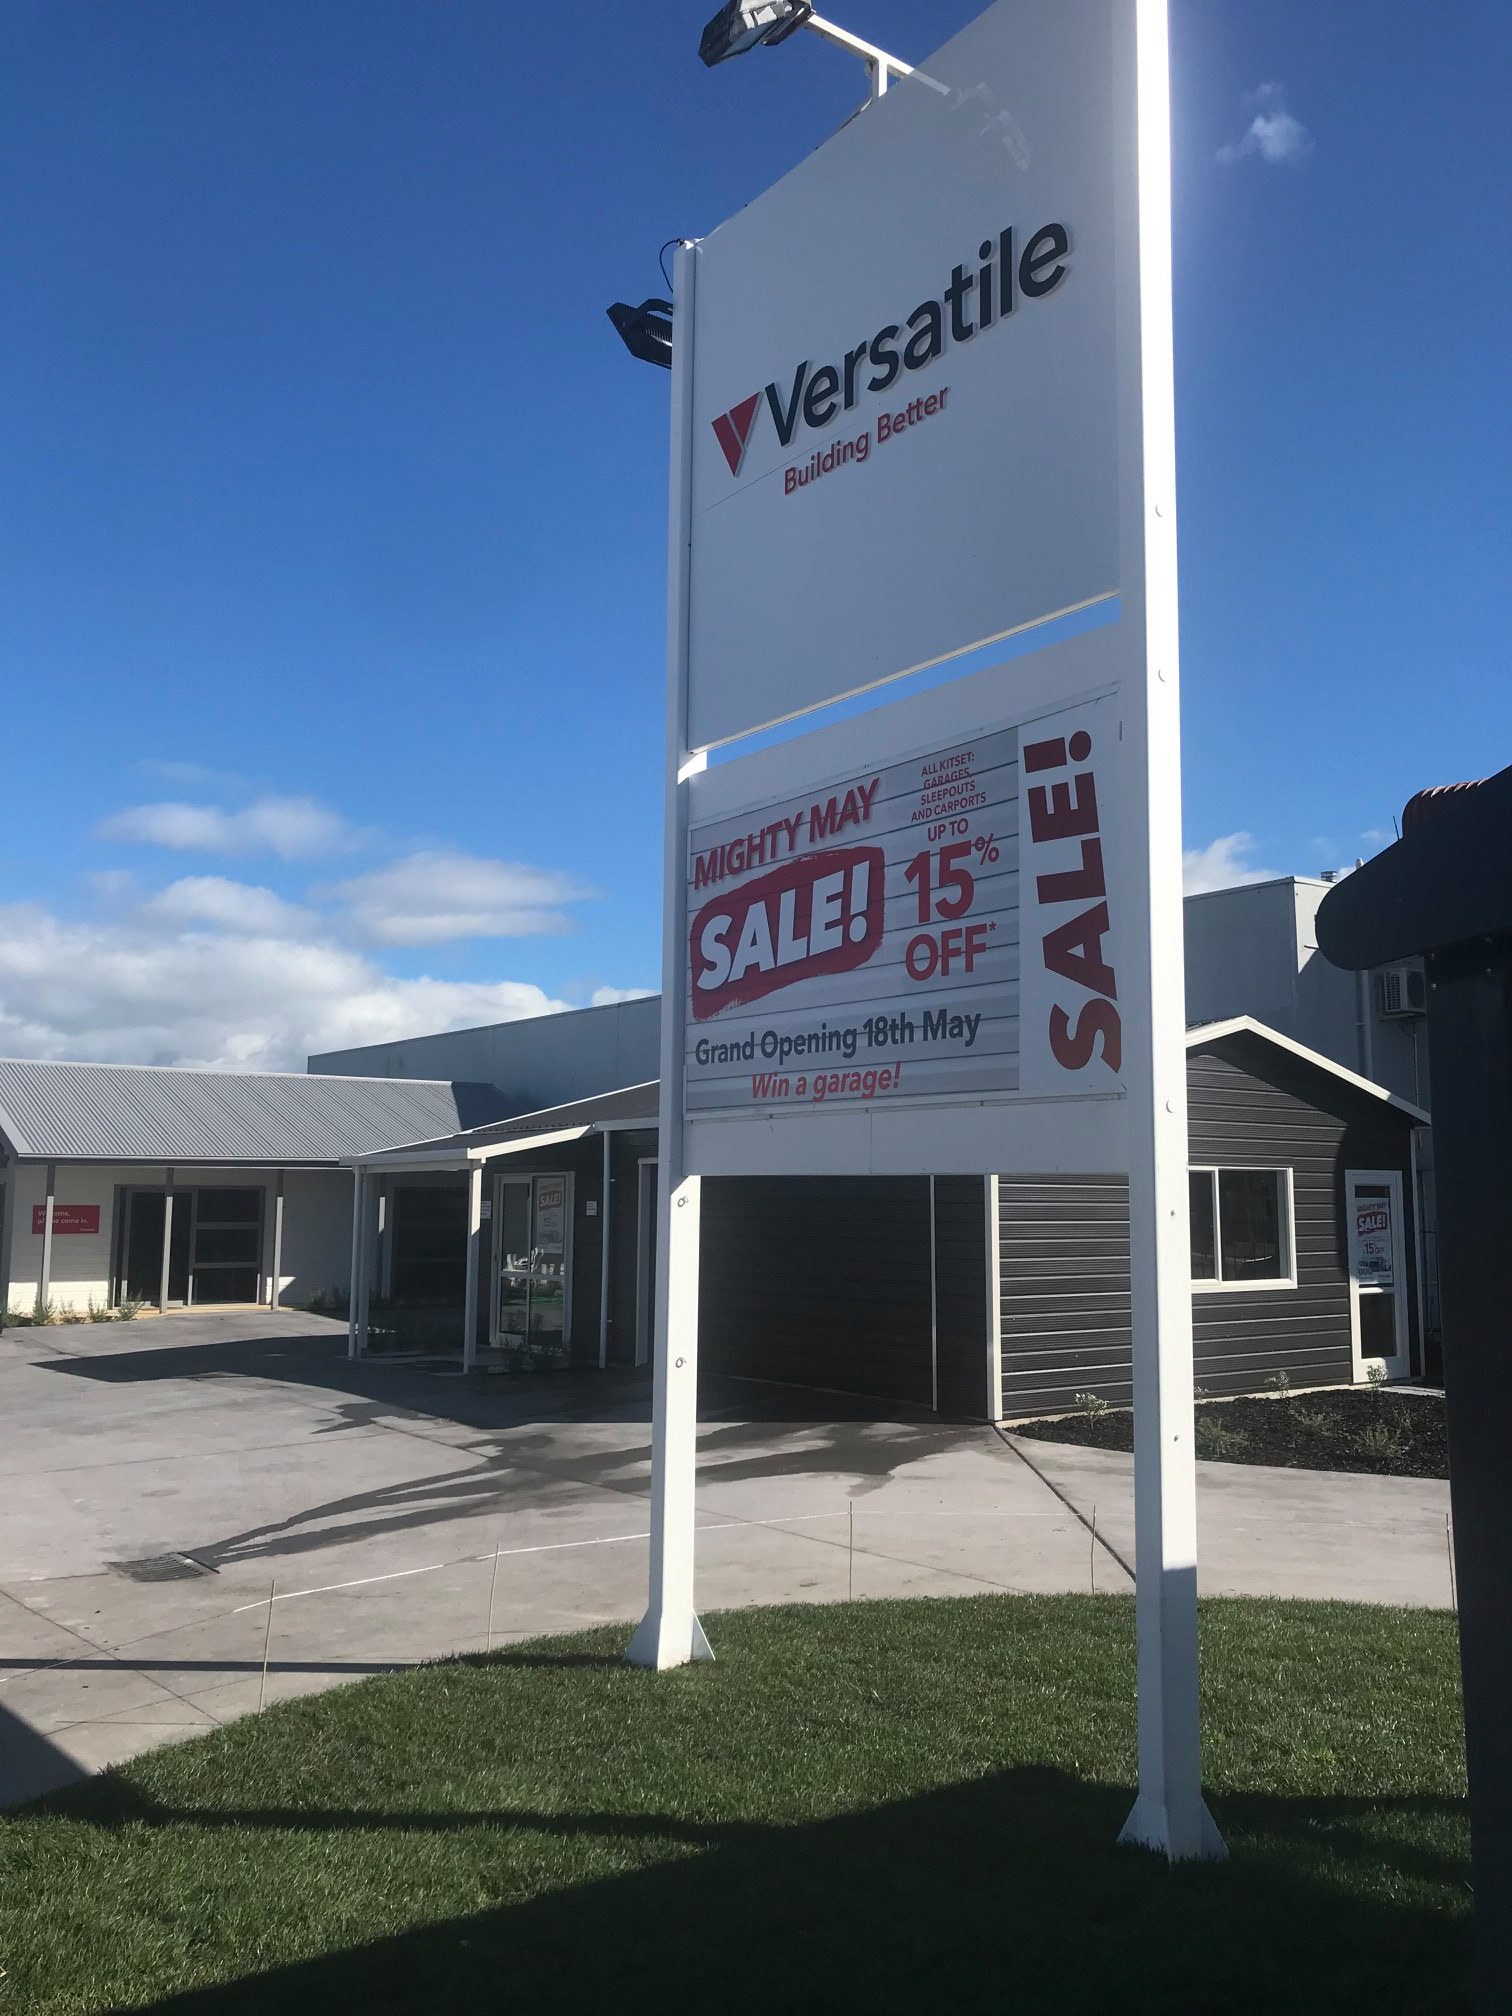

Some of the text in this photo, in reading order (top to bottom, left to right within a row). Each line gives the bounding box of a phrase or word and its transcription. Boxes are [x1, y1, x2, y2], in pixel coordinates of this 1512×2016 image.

[765, 222, 1069, 447] Versatile
[784, 386, 949, 495] Building Better
[921, 752, 975, 777] ALL KITSET:
[921, 780, 976, 805] SLEEPOUTS
[694, 777, 880, 890] MIGHTY MAY
[911, 791, 987, 822] AND CARPORTS
[928, 817, 969, 842] UP TO
[904, 833, 1000, 924] 15%
[1023, 730, 1122, 1073] SALE!
[696, 860, 870, 991] SALE!
[695, 1008, 982, 1066] Grand Opening 18th May
[752, 1060, 902, 1104] Win a garage!
[1358, 1214, 1386, 1232] SALE!
